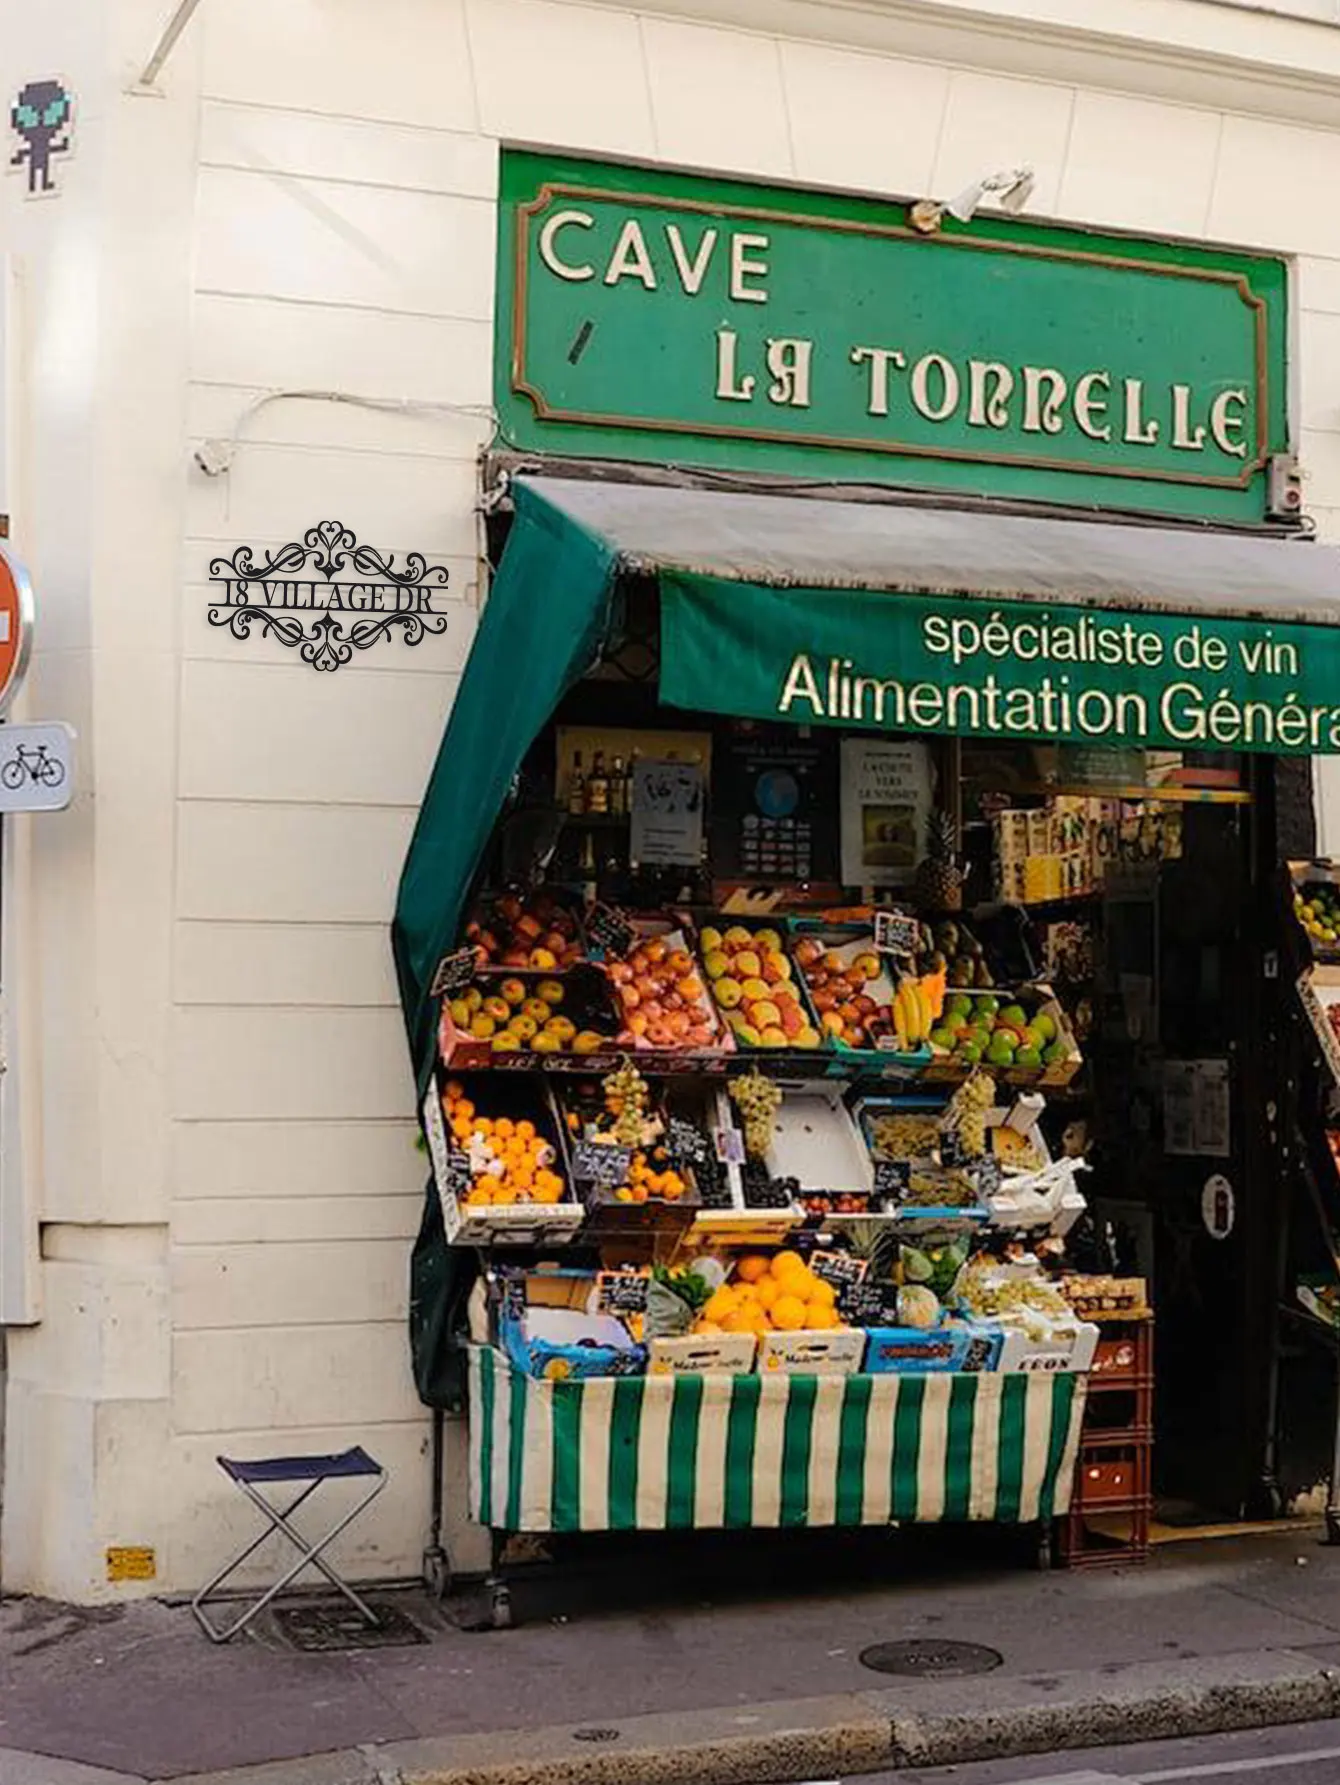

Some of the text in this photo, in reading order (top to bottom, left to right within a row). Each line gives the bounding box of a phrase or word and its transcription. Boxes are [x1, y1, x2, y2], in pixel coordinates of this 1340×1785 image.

[539, 209, 770, 304] CAVE
[714, 327, 1250, 459] LA TONNELLE
[224, 580, 434, 613] 18 VILLAGE DR
[922, 612, 1299, 676] spécialiste de vin
[777, 653, 1148, 736] Alimentation
